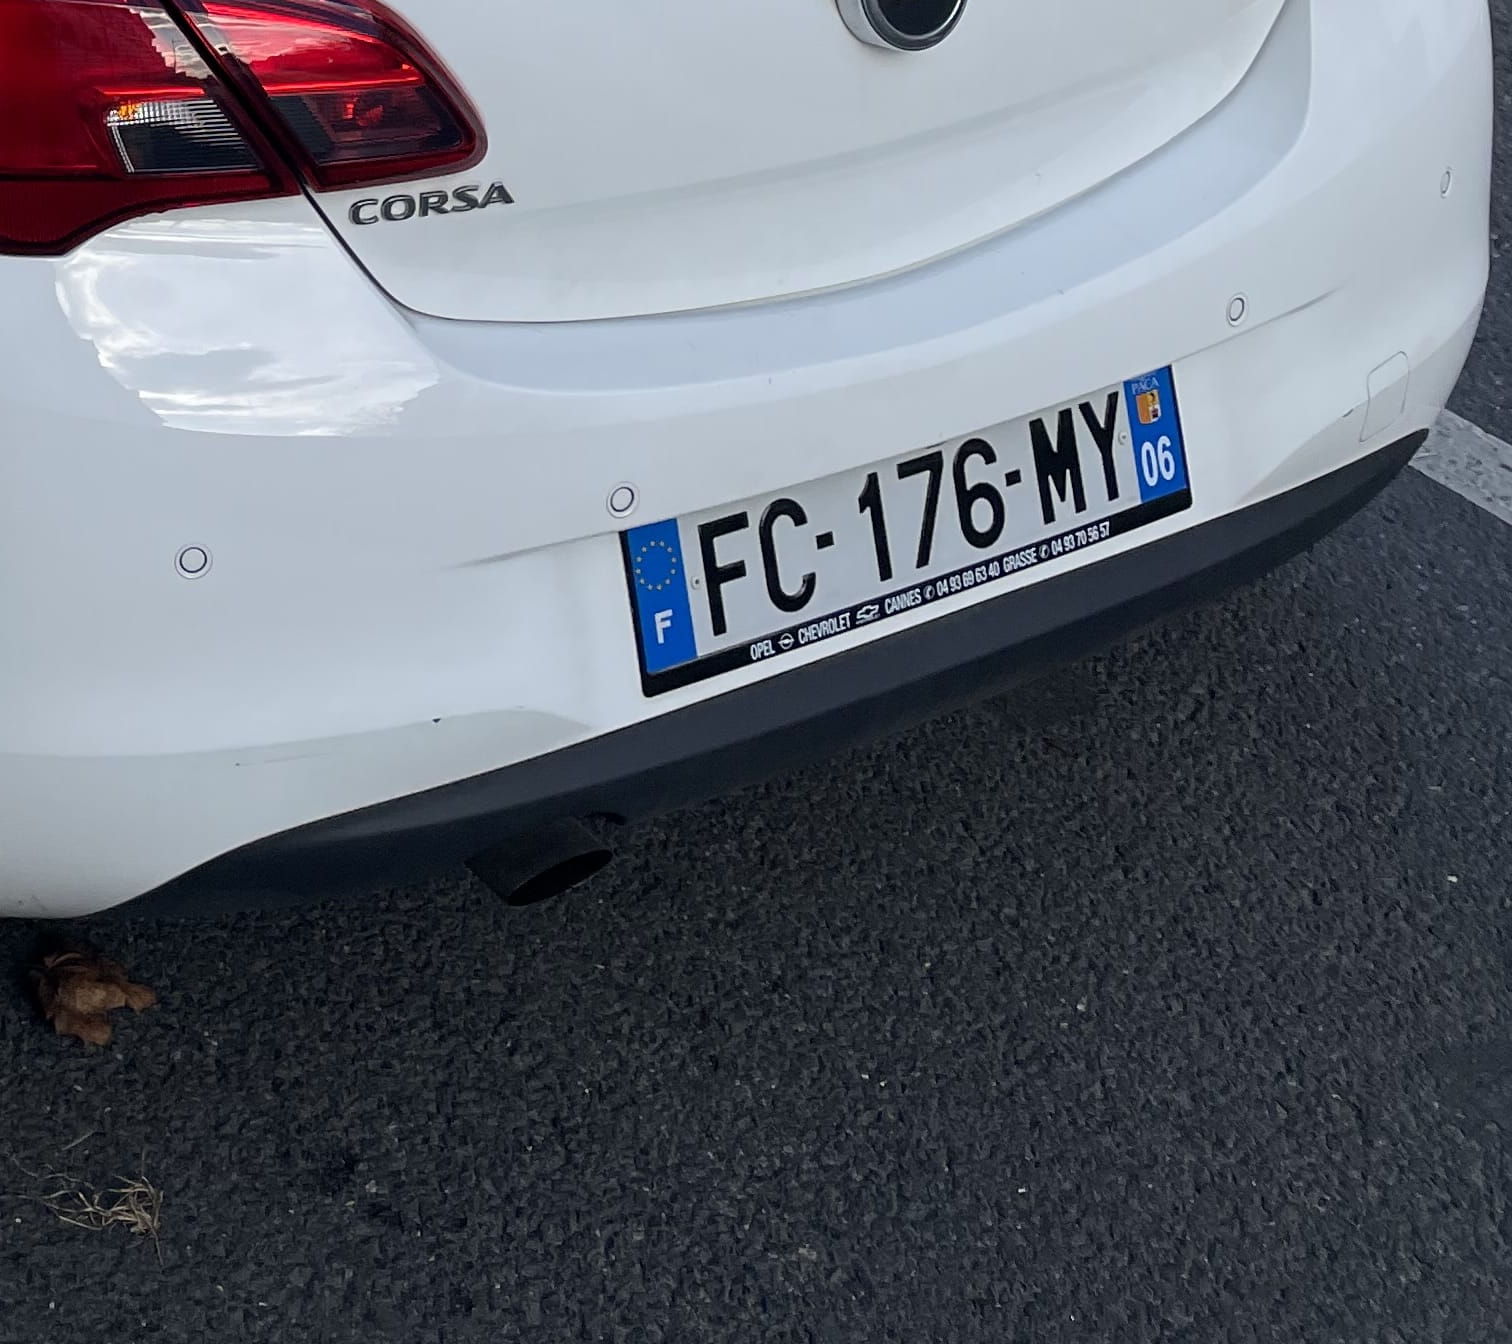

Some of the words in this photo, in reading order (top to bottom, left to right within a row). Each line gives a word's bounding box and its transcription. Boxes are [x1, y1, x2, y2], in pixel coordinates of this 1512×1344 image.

[348, 181, 515, 225] CORSA
[1131, 377, 1160, 395] PACA
[1140, 436, 1176, 487] 06
[698, 391, 1120, 637] FC-176-MY
[750, 639, 776, 660] OPEL
[797, 613, 851, 645] CHEVROLET
[884, 589, 922, 614] CANNES
[937, 580, 949, 596] 04
[949, 576, 962, 592] 93
[988, 561, 1000, 577] 40
[1003, 547, 1038, 573] GRASSE
[1051, 540, 1063, 556] 04
[1063, 534, 1076, 551] 93
[1076, 529, 1087, 546] 70
[654, 610, 674, 644] F
